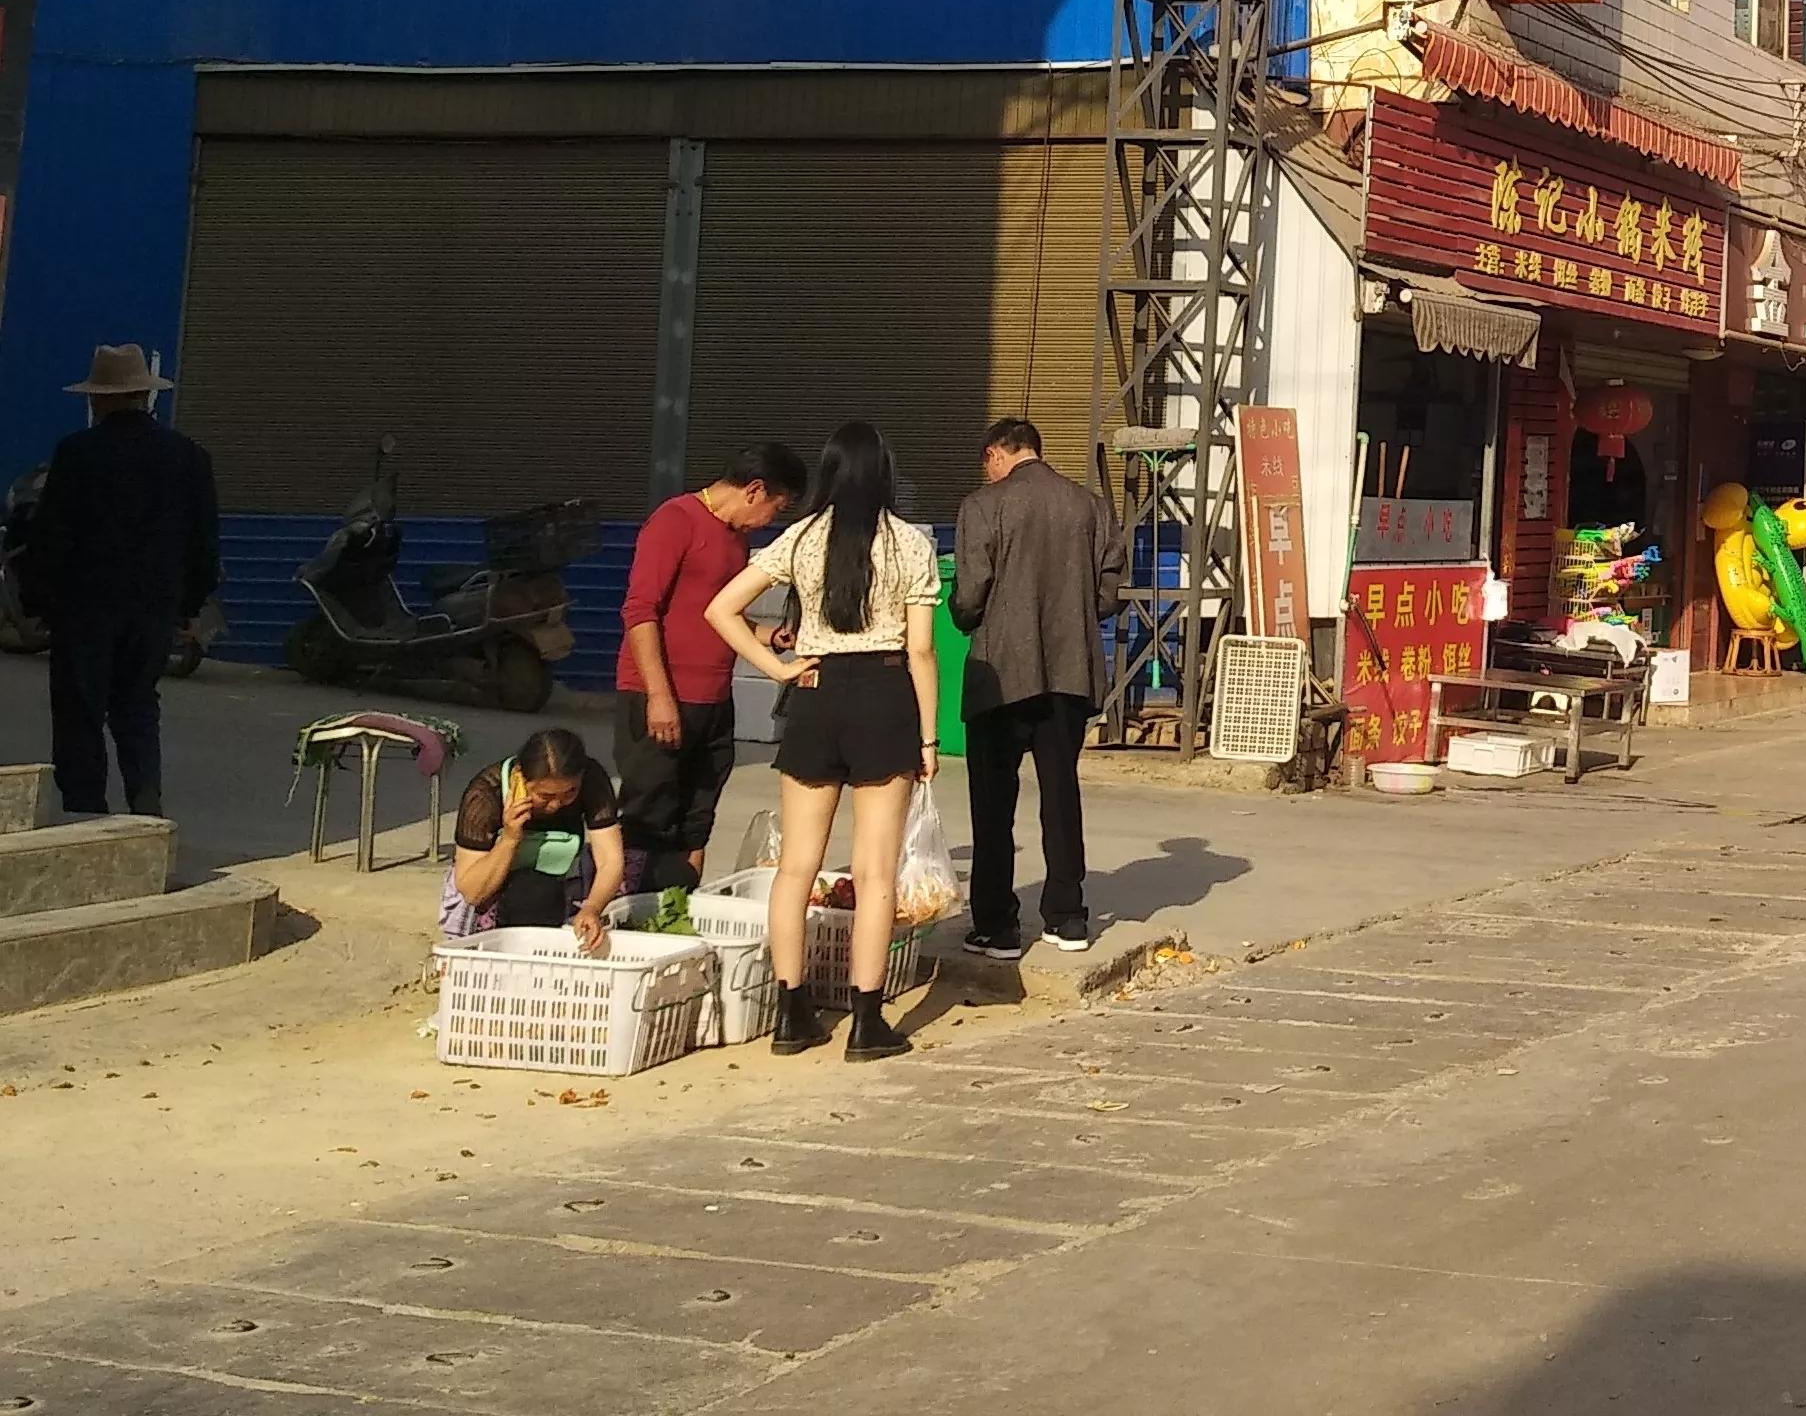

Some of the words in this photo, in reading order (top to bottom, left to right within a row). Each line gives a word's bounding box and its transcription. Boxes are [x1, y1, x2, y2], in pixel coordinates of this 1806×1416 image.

[1491, 154, 1708, 285] 陈记小锅米线
[1268, 506, 1297, 638] 早点
[1365, 579, 1471, 631] 早点小吃
[1401, 643, 1433, 682] 卷粉
